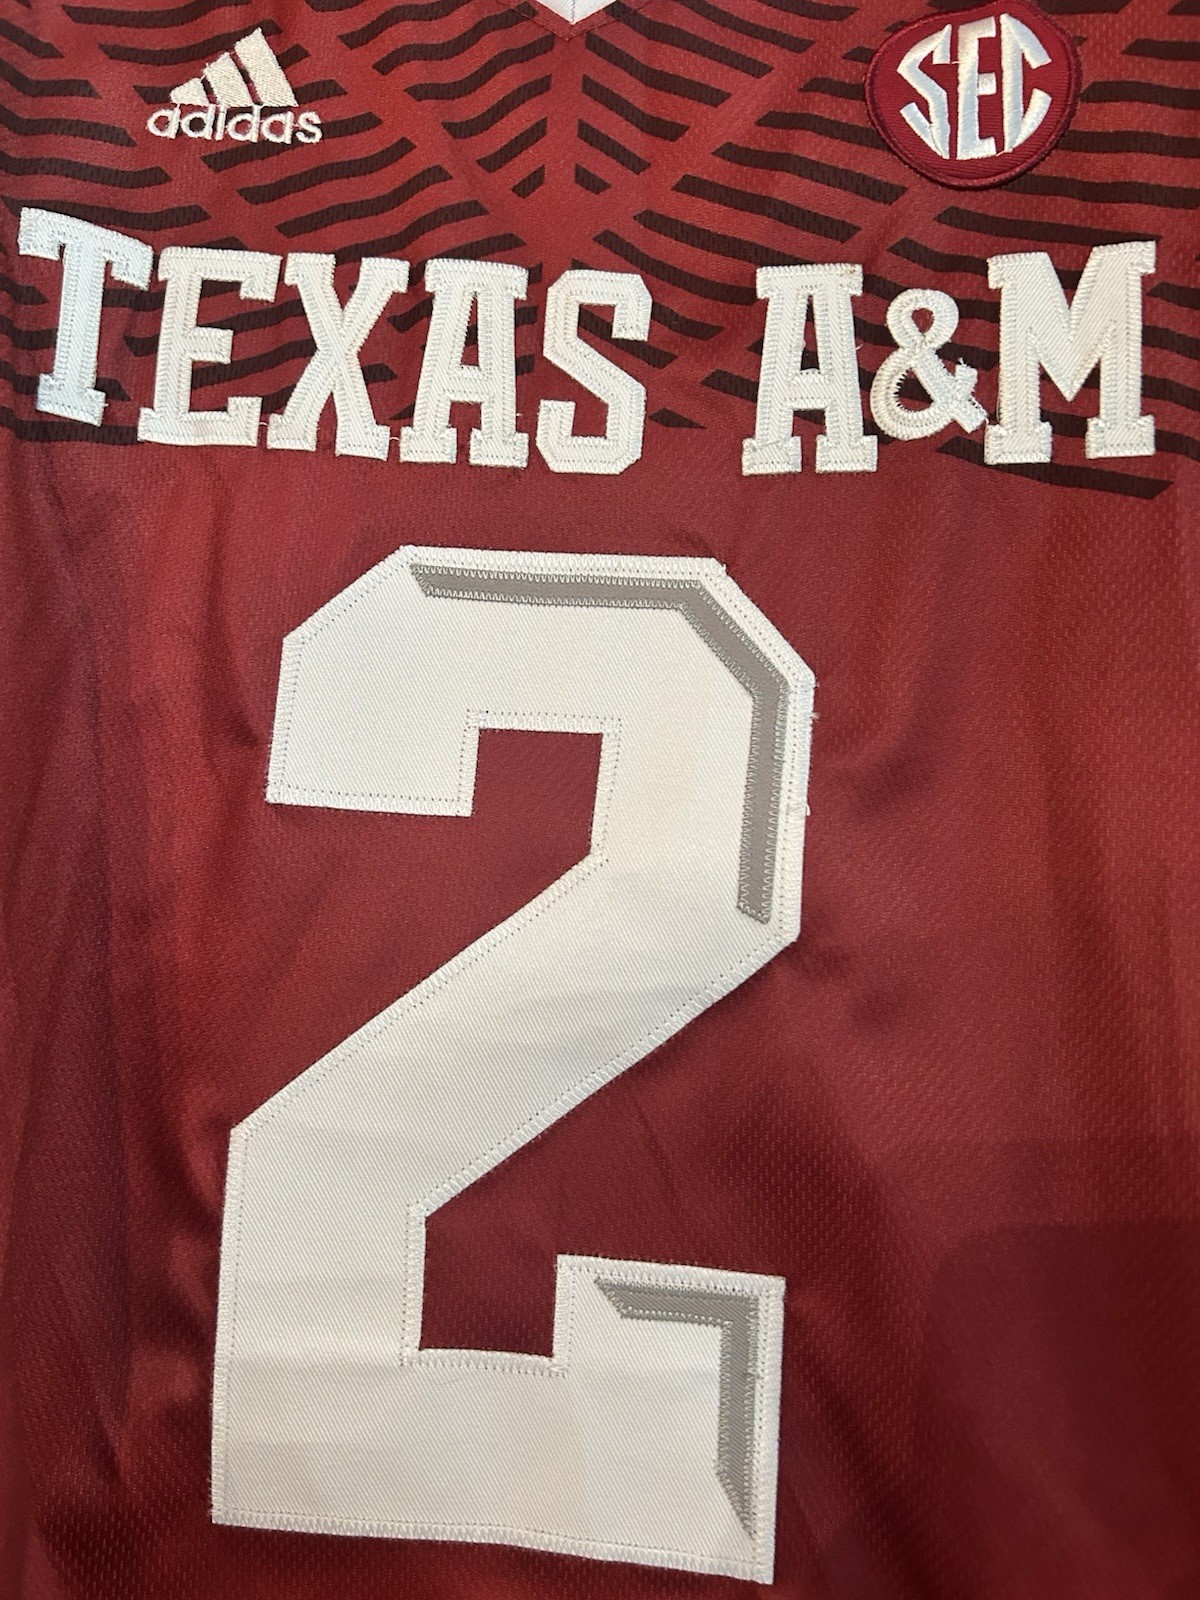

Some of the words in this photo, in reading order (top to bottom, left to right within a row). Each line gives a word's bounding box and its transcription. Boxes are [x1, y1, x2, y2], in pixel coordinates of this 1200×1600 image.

[147, 103, 323, 145] adidas
[897, 13, 1052, 161] SEC
[18, 207, 653, 475] TEXAS
[741, 240, 1157, 476] A&M
[211, 544, 816, 1585] 2
